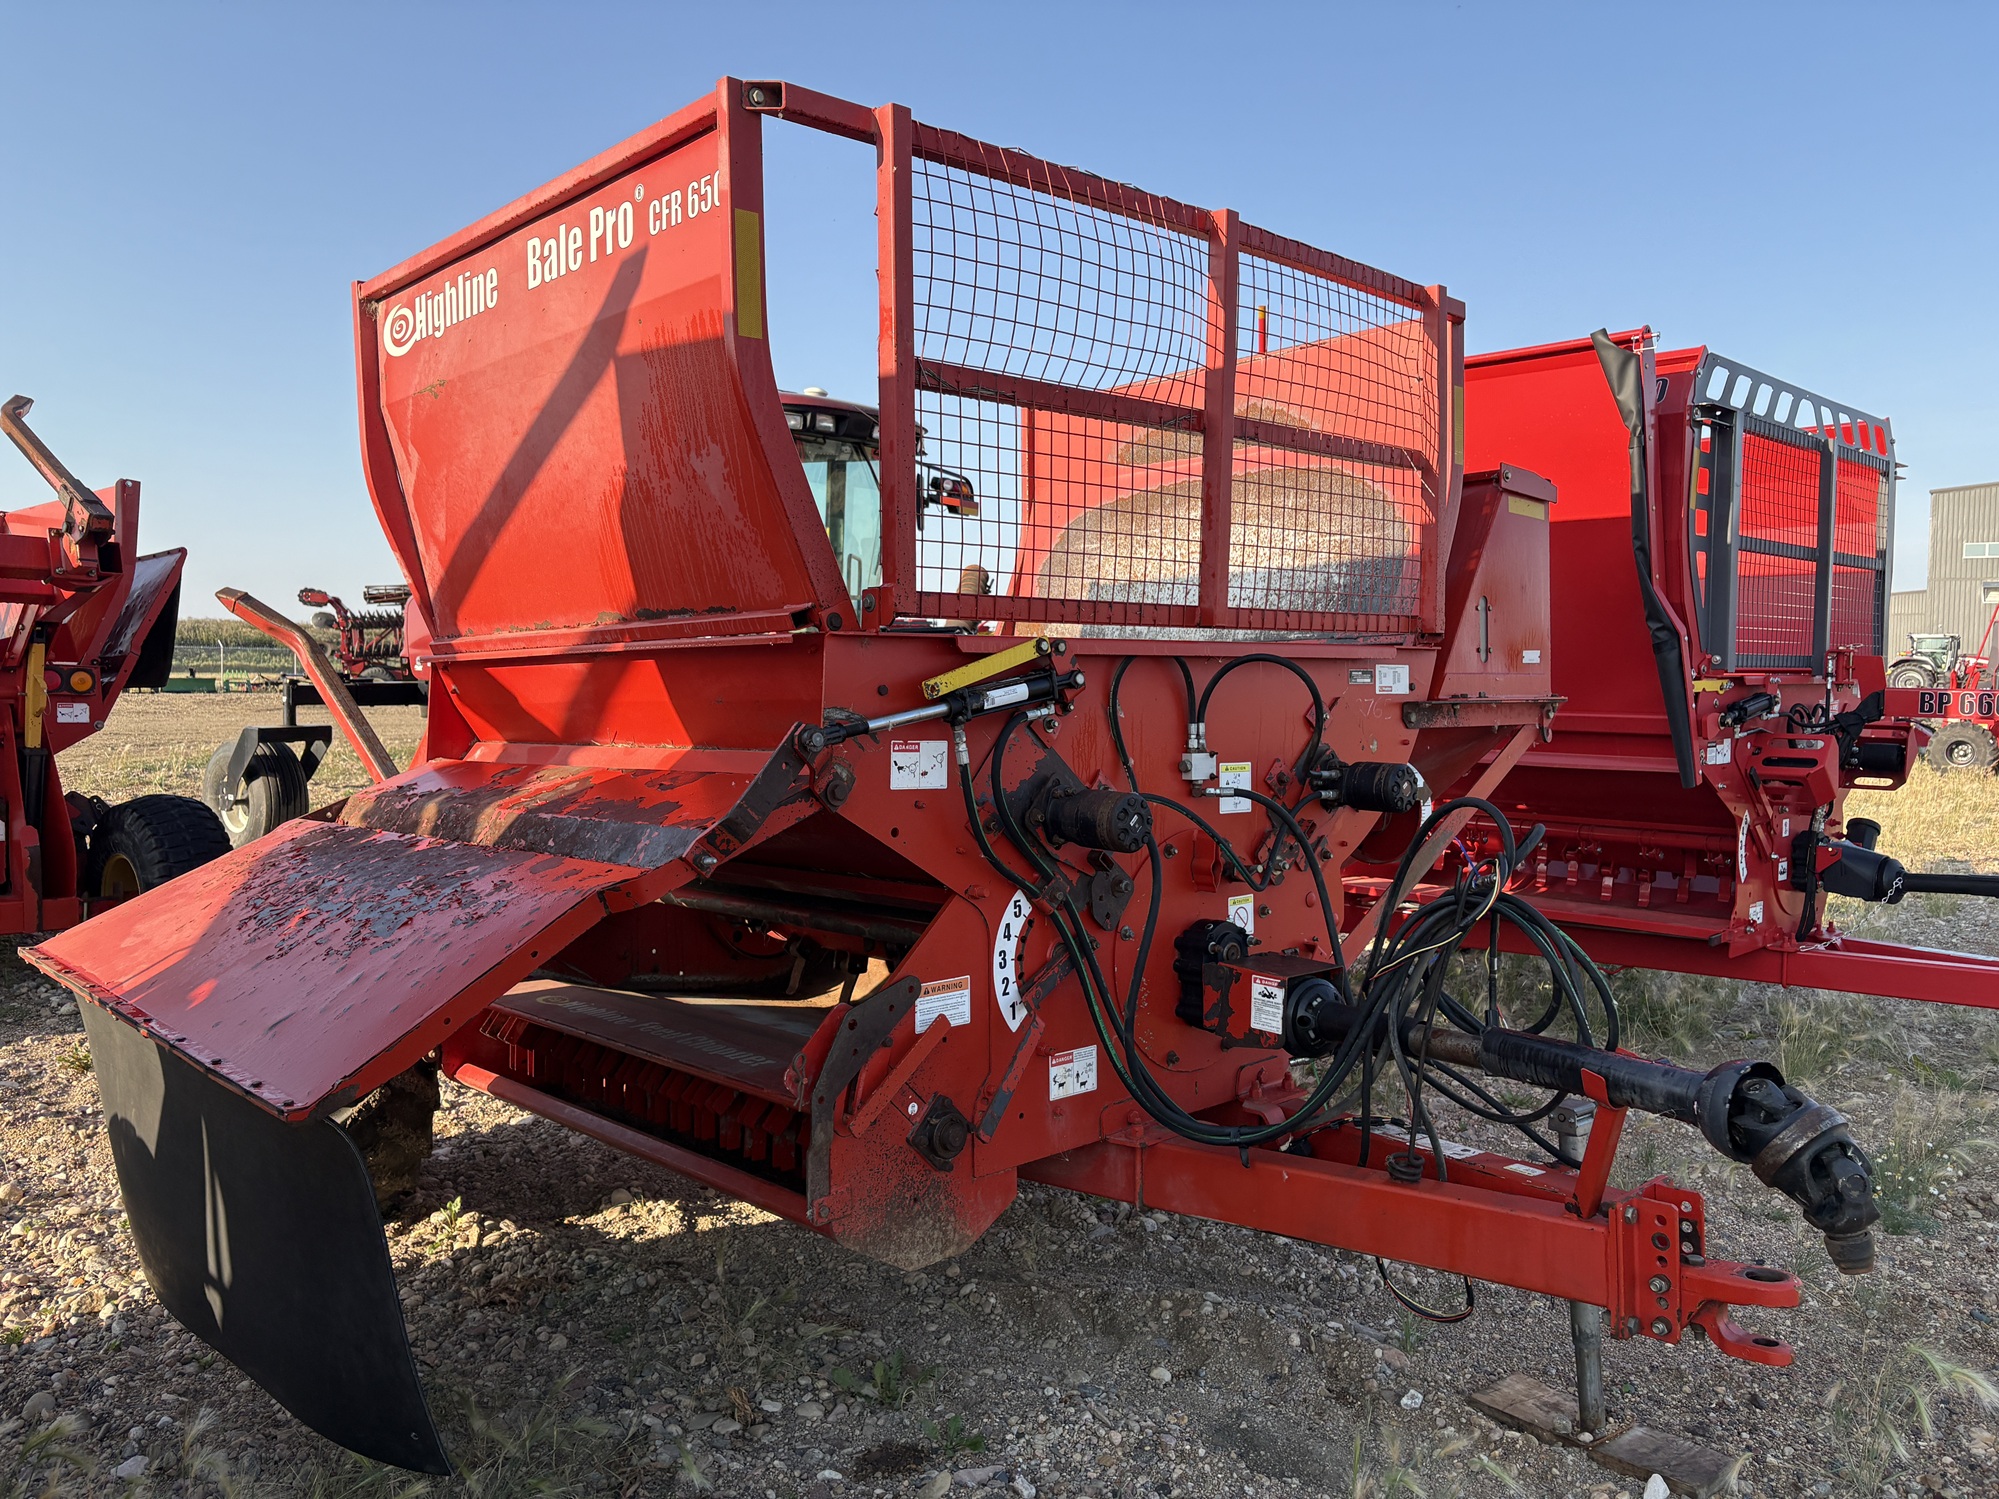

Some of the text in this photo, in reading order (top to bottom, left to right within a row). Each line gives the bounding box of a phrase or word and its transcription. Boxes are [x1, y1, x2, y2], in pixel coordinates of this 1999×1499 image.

[414, 267, 499, 341] Highline
[526, 223, 583, 292] Bale
[649, 188, 683, 236] CFR
[1919, 691, 1999, 717] BP 66
[1013, 899, 1022, 918] 5
[1003, 922, 1012, 942] 4
[998, 949, 1008, 970] 3
[931, 981, 963, 994] WARNING
[1001, 976, 1010, 997] 2
[1261, 979, 1279, 987] DANGE
[1009, 1001, 1017, 1020] 1
[1055, 1055, 1073, 1064] DANGER
